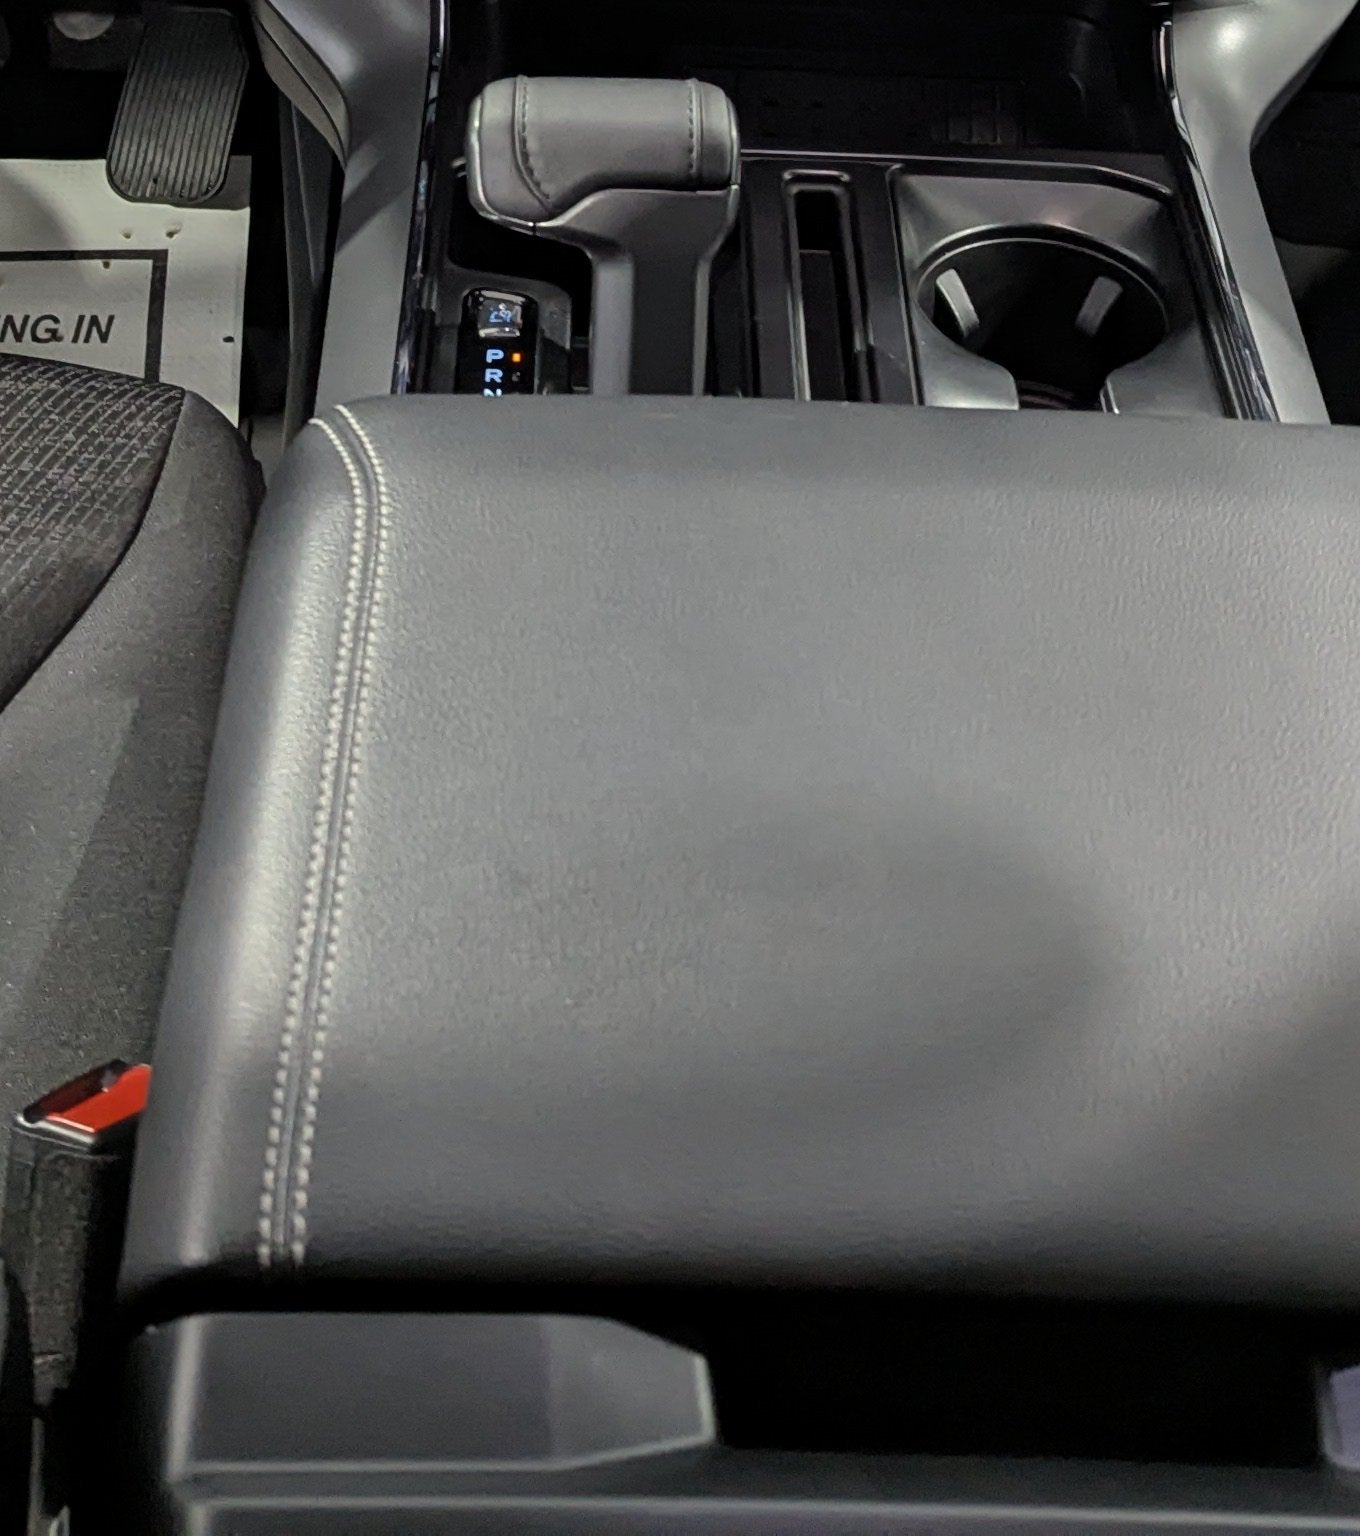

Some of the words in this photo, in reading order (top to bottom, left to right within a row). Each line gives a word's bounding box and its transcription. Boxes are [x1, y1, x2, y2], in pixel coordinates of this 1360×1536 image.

[71, 314, 115, 344] IN
[485, 349, 504, 363] P
[484, 368, 503, 383] R
